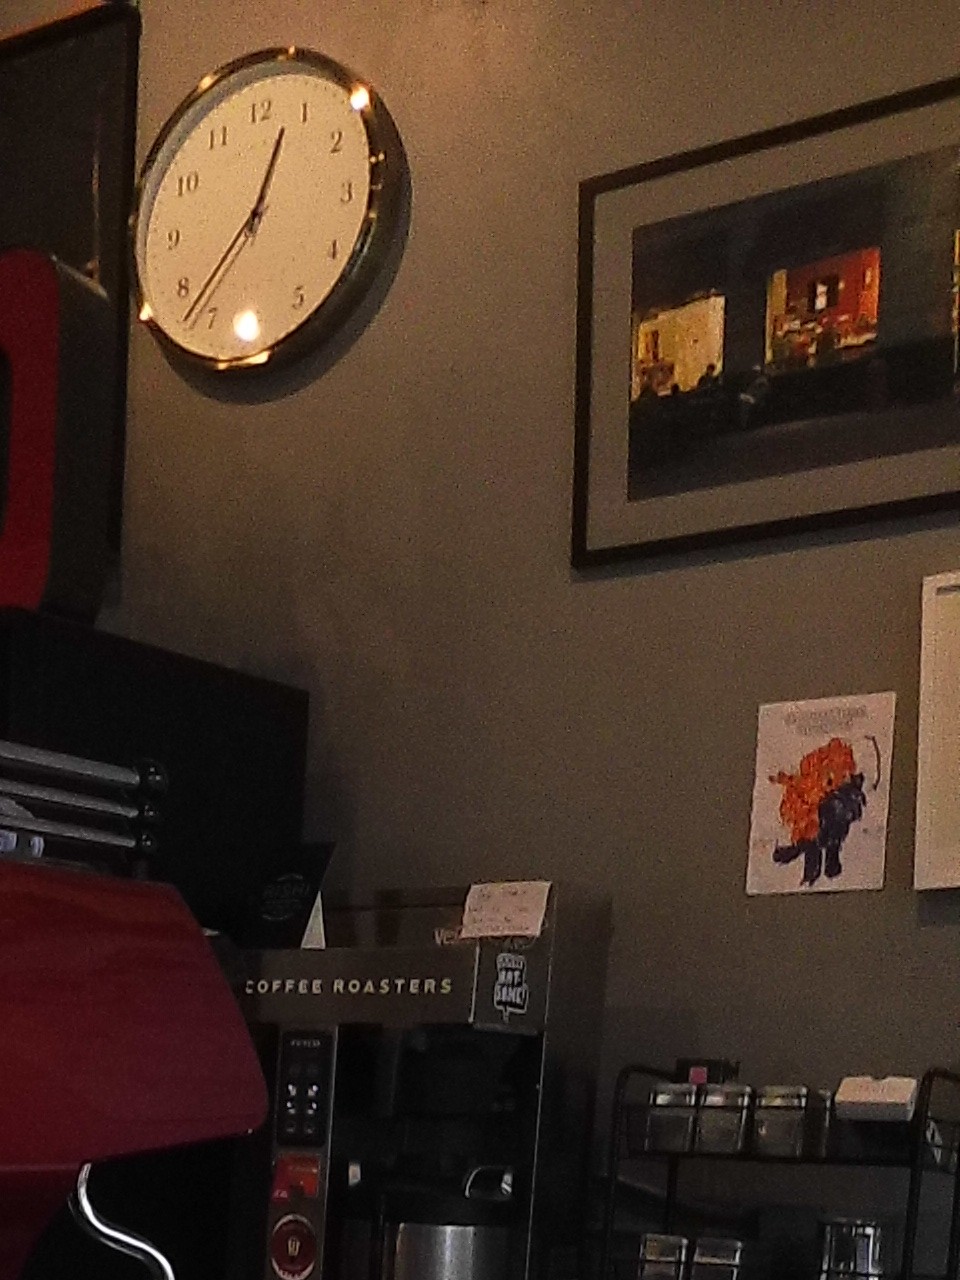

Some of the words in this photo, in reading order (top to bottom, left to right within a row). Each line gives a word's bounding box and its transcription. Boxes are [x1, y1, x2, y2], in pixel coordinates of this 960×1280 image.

[251, 100, 272, 123] 12
[300, 102, 308, 123] 1
[208, 126, 228, 149] 11
[330, 130, 343, 153] 2
[178, 171, 199, 196] 10
[341, 182, 353, 204] 3
[167, 229, 180, 250] 9
[328, 239, 337, 260] 4
[177, 277, 189, 298] 8
[293, 285, 304, 309] 5
[208, 307, 217, 329] 7
[245, 978, 323, 995] COFFEE
[333, 978, 453, 995] ROASTERS
